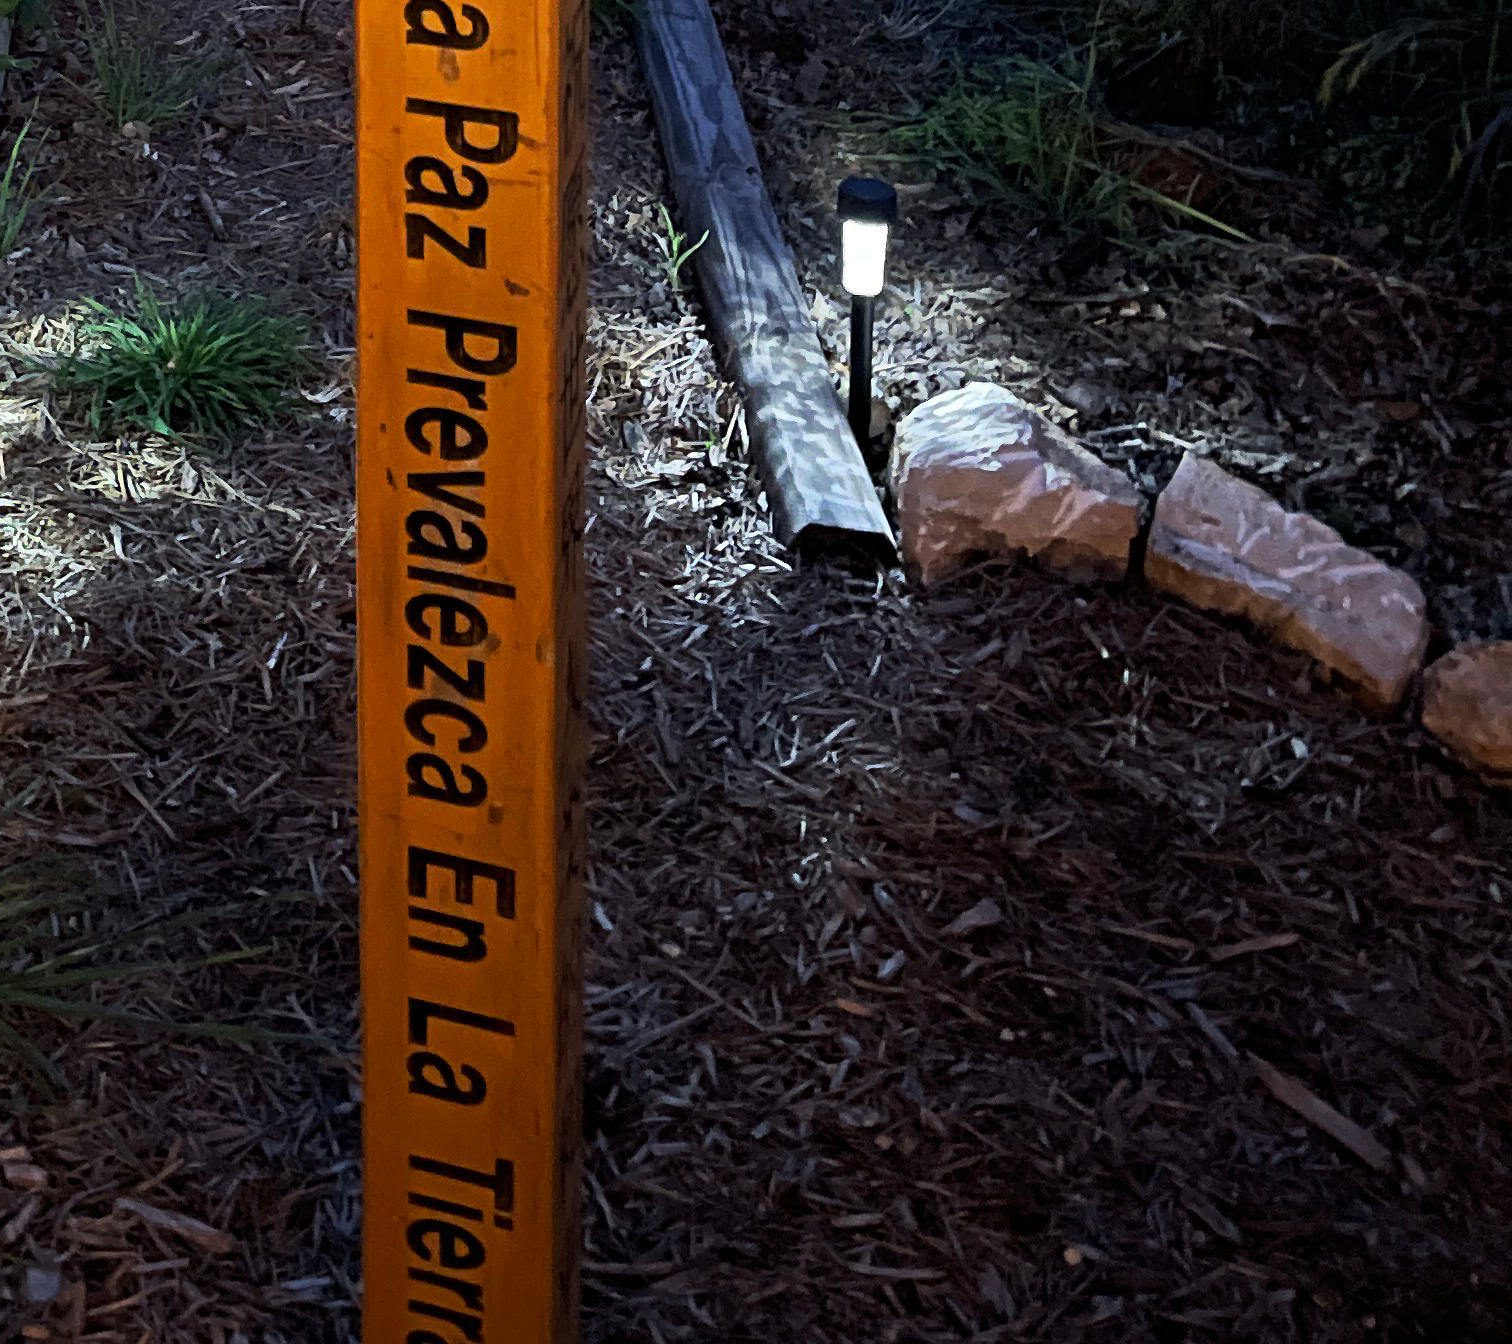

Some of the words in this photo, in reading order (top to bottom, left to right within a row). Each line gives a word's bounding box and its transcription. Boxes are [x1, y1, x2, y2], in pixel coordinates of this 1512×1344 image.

[405, 98, 523, 269] Paz
[404, 309, 517, 807] Prevalezca
[408, 846, 515, 962] En
[407, 997, 515, 1106] La
[406, 1155, 514, 1344] Tierr
